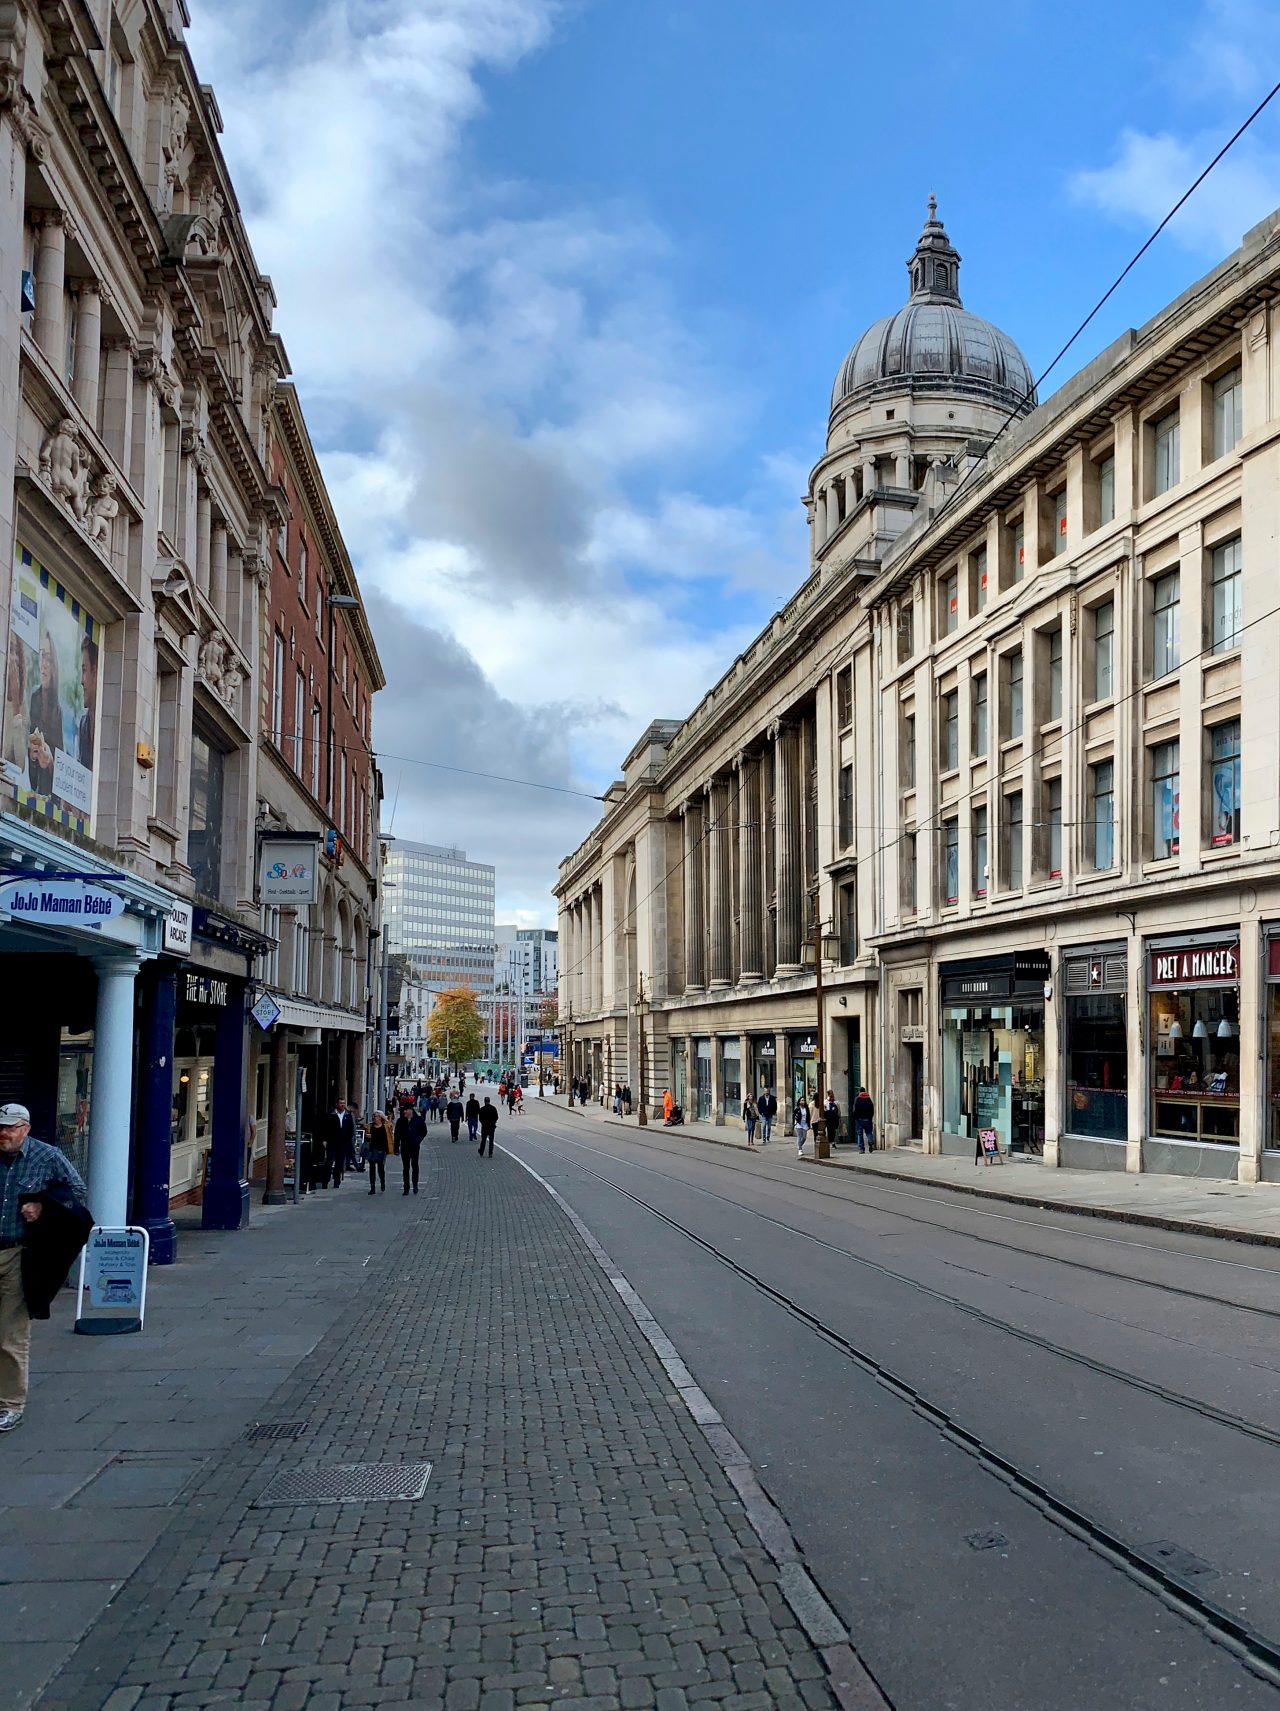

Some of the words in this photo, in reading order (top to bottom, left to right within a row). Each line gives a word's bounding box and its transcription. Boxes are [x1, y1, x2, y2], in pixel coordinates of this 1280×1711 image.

[11, 892, 38, 911] JoJo
[40, 893, 82, 914] Maman
[84, 894, 112, 915] Bébé
[169, 926, 187, 944] ARCADE
[1157, 955, 1179, 980] PRET
[1182, 954, 1189, 978] A
[1192, 950, 1232, 977] MANGER
[210, 980, 228, 1006] STORE
